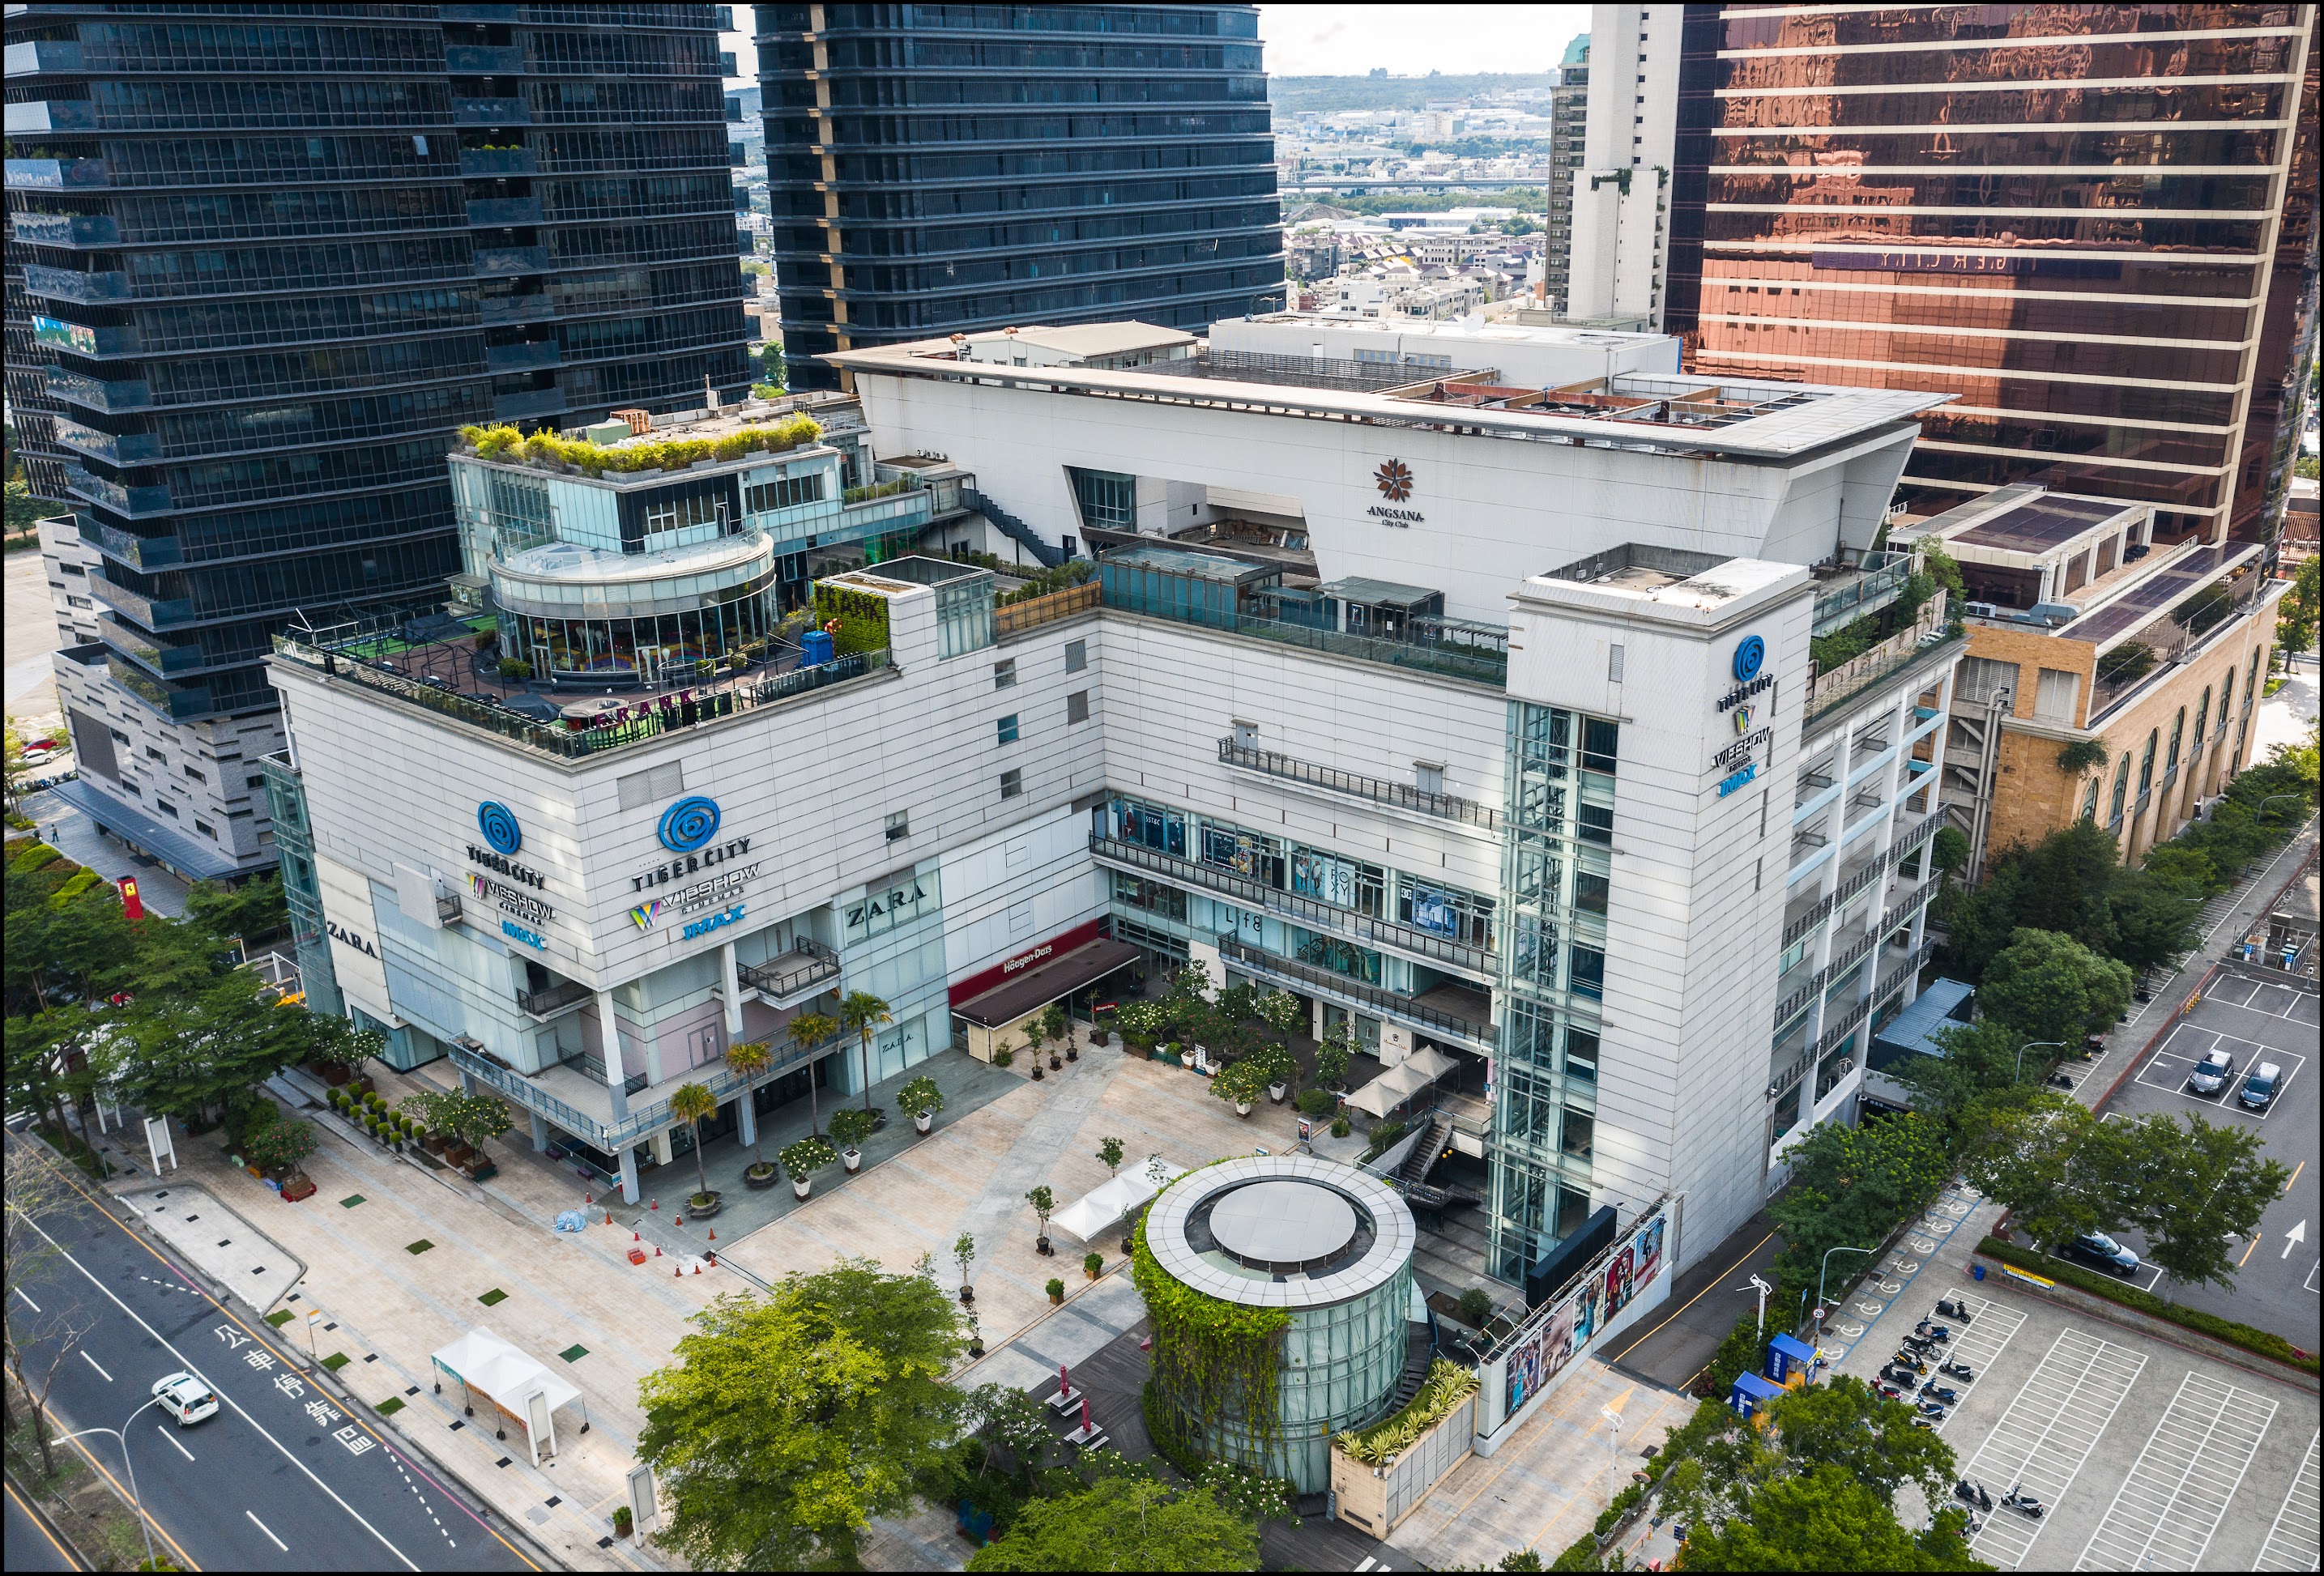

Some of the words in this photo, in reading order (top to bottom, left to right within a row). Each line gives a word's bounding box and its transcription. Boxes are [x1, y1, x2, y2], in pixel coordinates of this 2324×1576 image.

[1367, 506, 1425, 522] ANGSANA
[1382, 519, 1393, 527] City
[595, 689, 693, 730] FRANK
[1714, 726, 1770, 768] VIESHOW
[1718, 764, 1757, 798] IMAX
[486, 880, 553, 921] VIESHOW
[663, 863, 761, 908] VIESHOW
[683, 904, 747, 941] IMAX
[848, 884, 927, 927] ZARA
[326, 920, 378, 959] ZARA
[501, 919, 546, 952] IMAX
[1857, 1094, 1868, 1102] P
[214, 1323, 377, 1456] 公車停靠區
